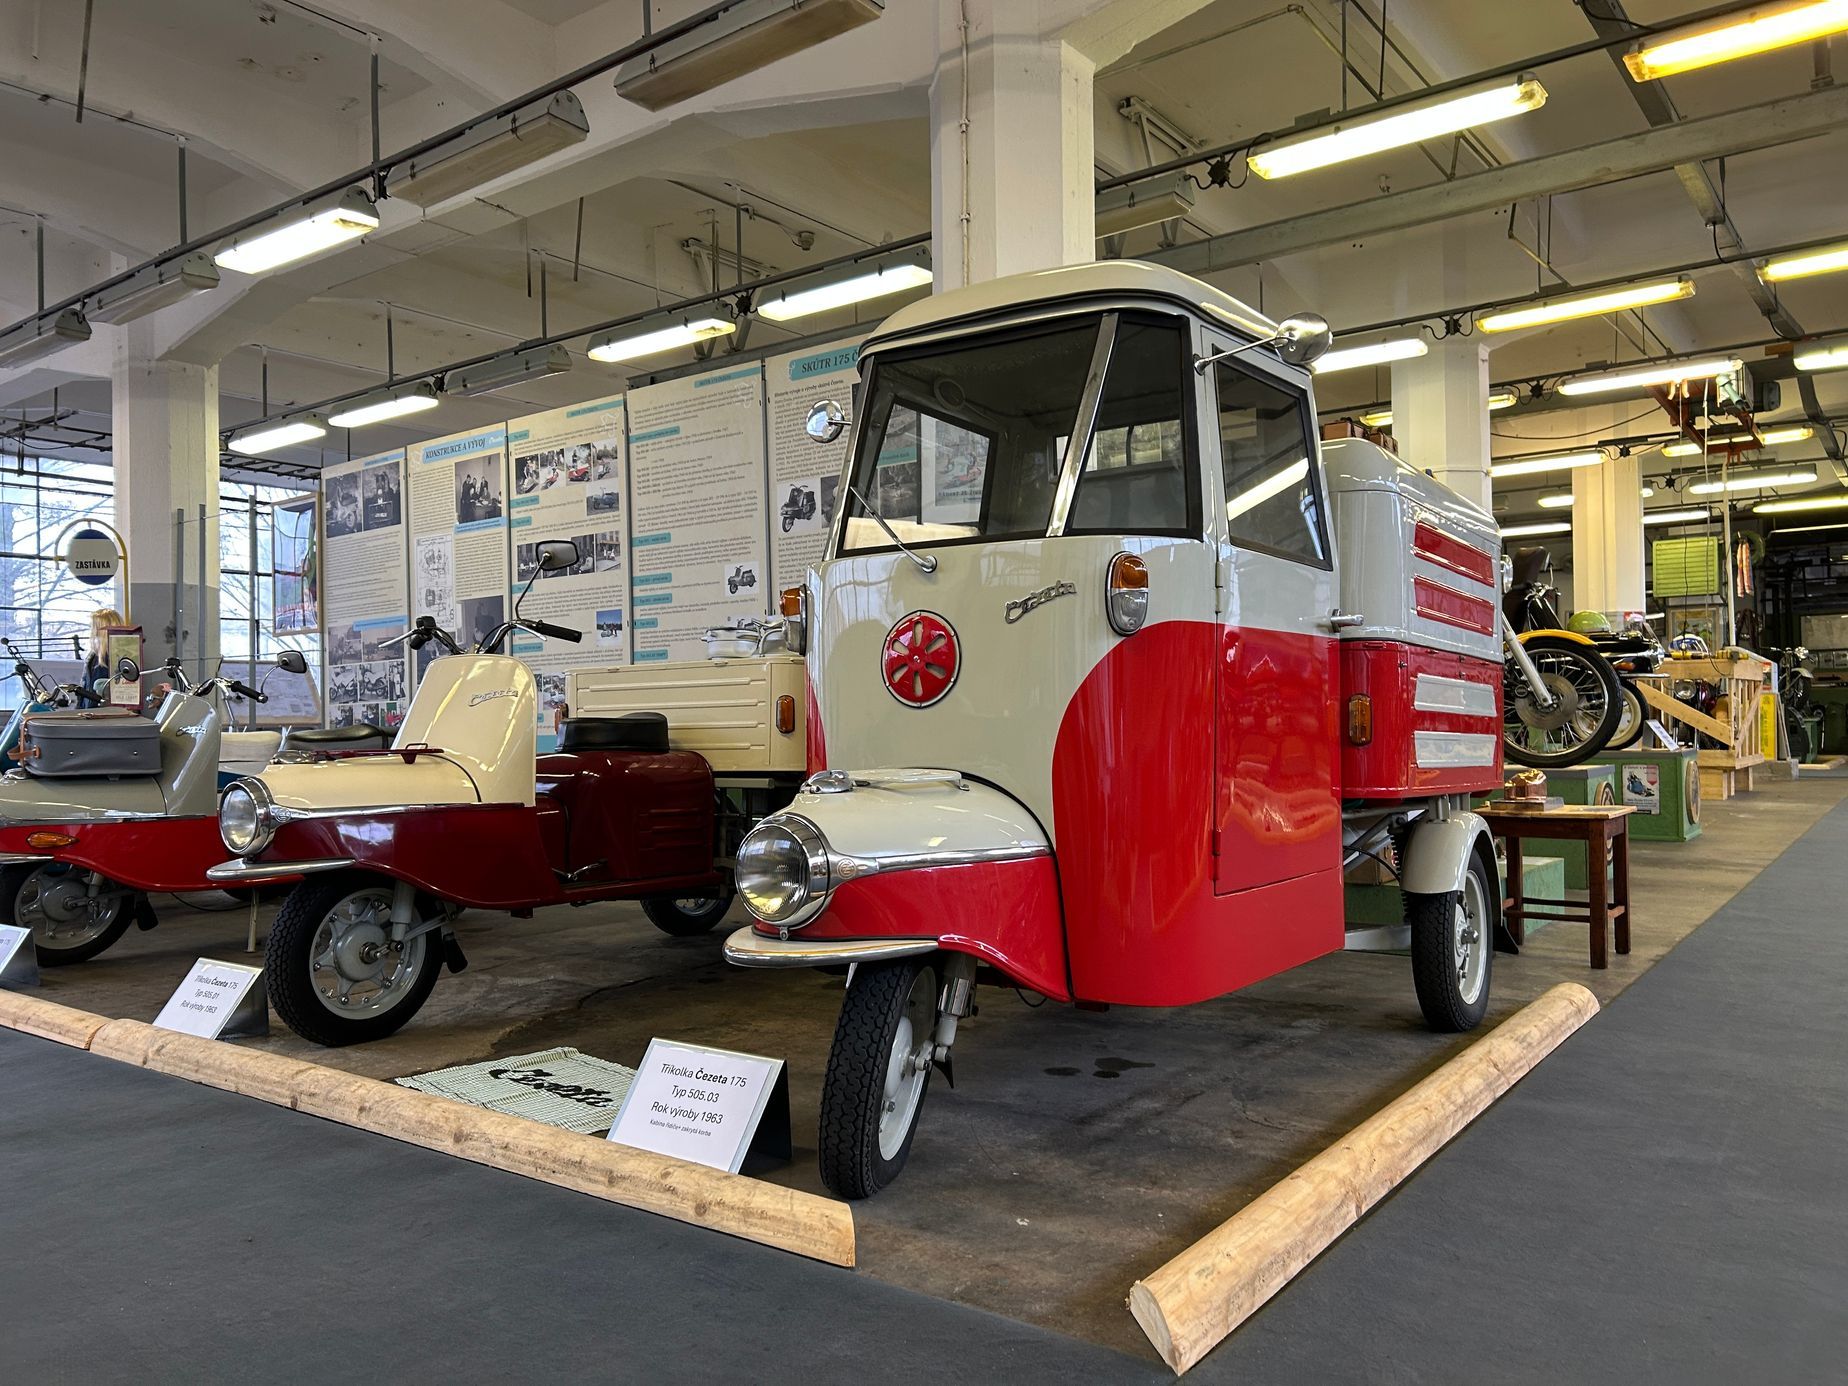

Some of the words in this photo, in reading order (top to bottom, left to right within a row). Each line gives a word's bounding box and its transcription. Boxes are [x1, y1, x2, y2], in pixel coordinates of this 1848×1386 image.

[802, 358, 831, 374] SKÚTR
[834, 352, 850, 366] 175
[425, 443, 461, 458] KONSTRUKCE
[467, 438, 486, 450] VÝVOJ
[75, 559, 111, 569] ZASTÁVKA
[211, 976, 228, 988] Čezeta
[228, 981, 239, 990] 175
[194, 988, 204, 998] Typ
[189, 1003, 205, 1012] výroby
[661, 1064, 694, 1078] Tříkolka
[695, 1068, 728, 1084] Čezeta
[730, 1076, 747, 1087] 175
[672, 1085, 686, 1098] Typ
[688, 1088, 720, 1103] 505.03
[651, 1101, 669, 1114] Rok
[670, 1106, 700, 1122] výroby
[701, 1112, 723, 1124] 1963
[650, 1119, 665, 1128] Kabina
